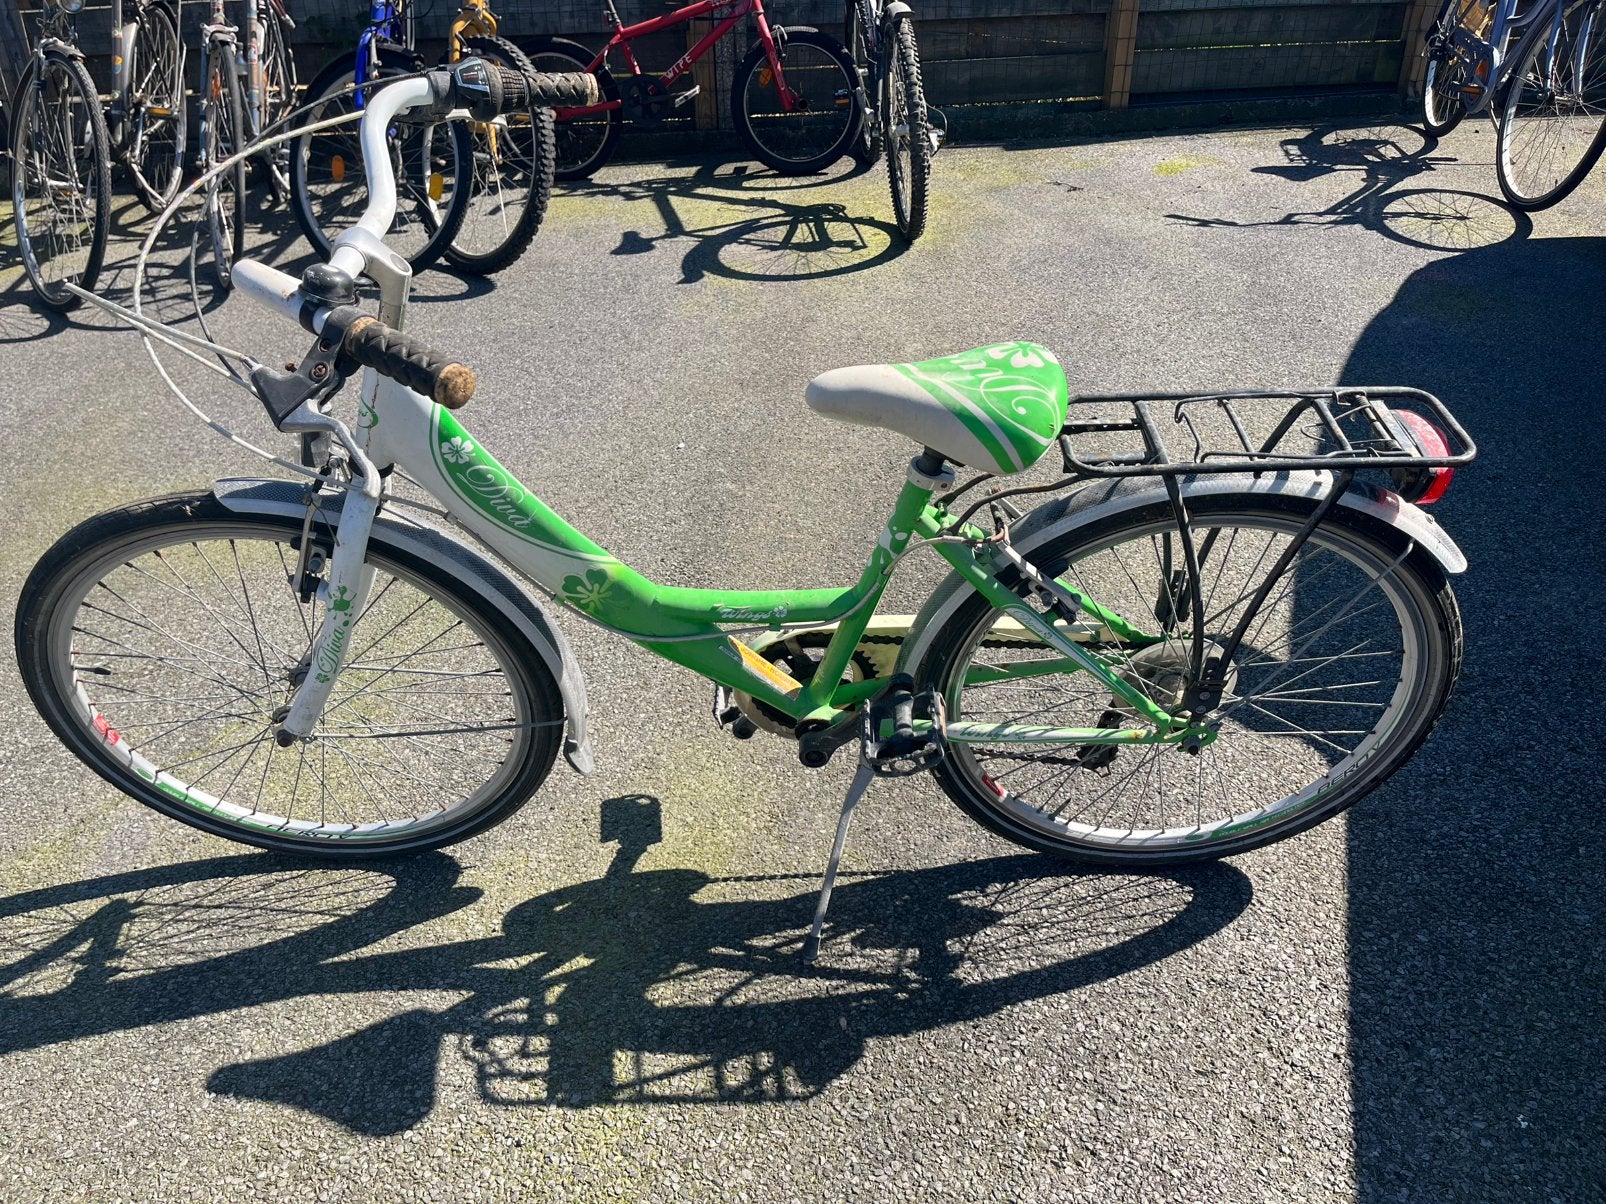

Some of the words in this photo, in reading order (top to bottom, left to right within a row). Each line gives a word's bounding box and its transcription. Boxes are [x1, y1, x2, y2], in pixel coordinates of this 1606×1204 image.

[456, 465, 538, 528] Diva
[719, 605, 773, 621] Wings
[316, 625, 346, 675] Diva
